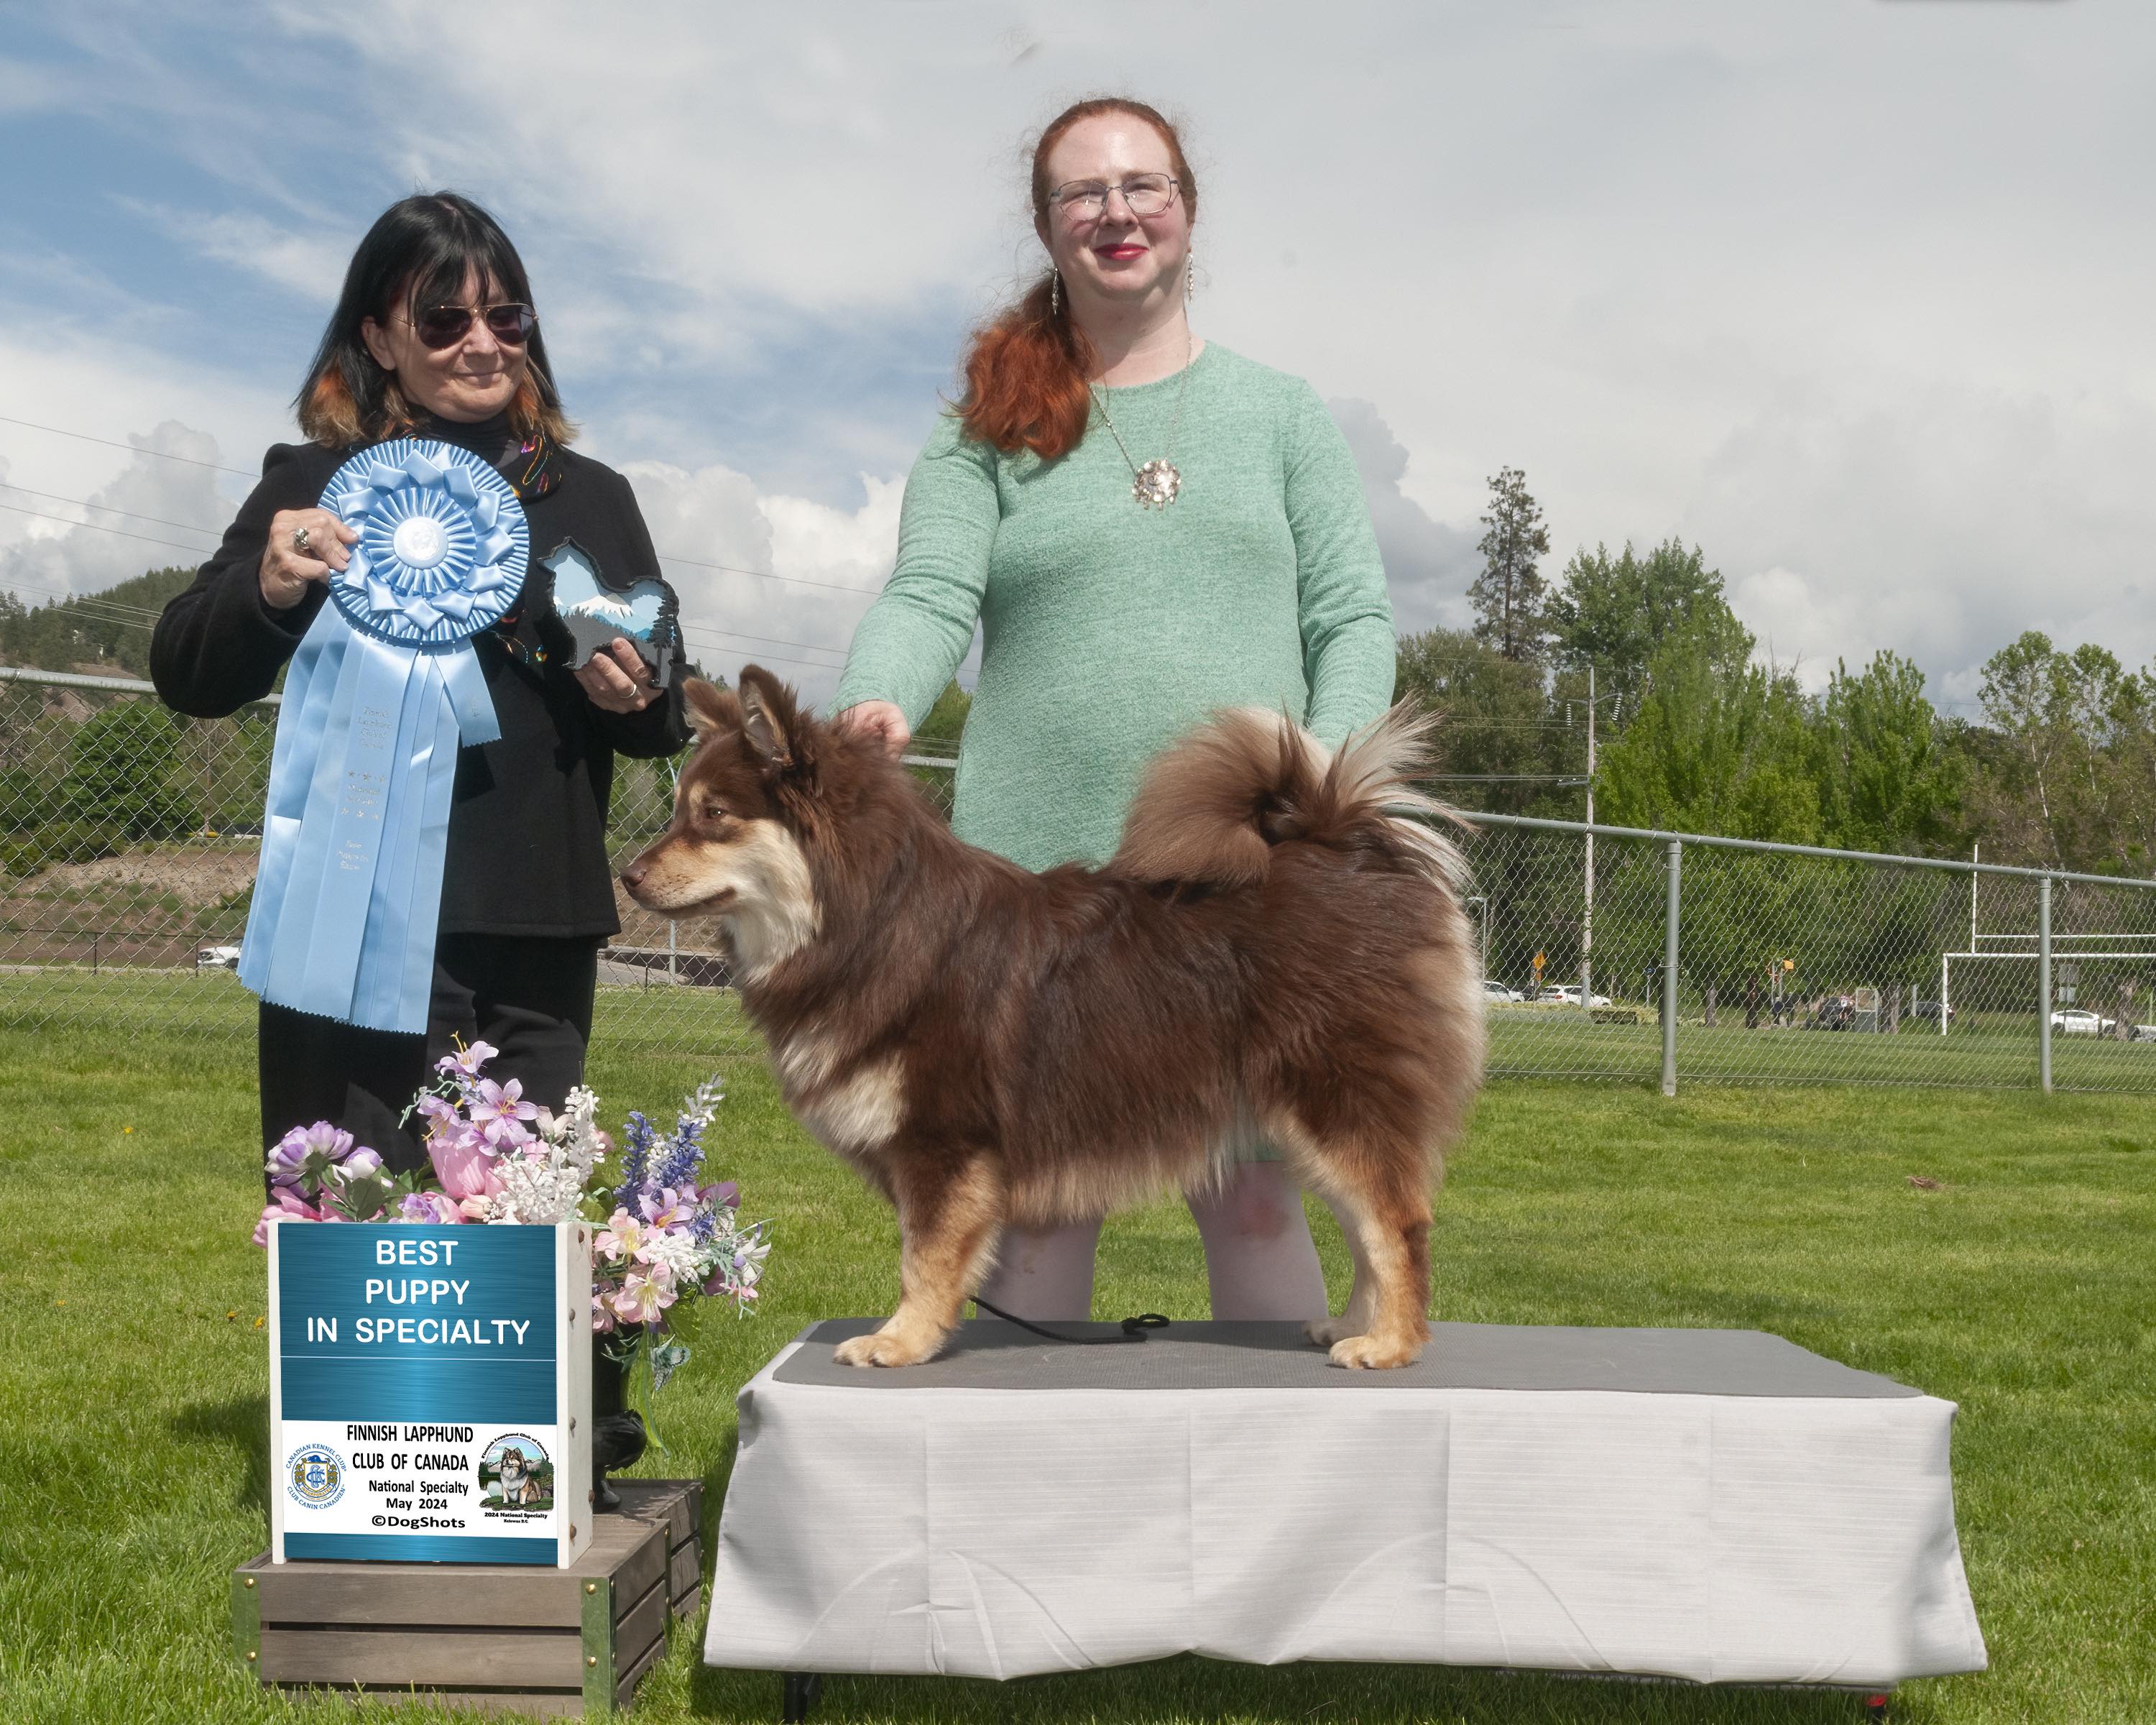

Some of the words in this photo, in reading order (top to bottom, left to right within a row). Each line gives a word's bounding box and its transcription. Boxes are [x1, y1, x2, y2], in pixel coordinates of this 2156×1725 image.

[376, 1240, 459, 1266] BEST
[366, 1279, 470, 1305] PUPPY
[308, 1317, 337, 1343] IN
[356, 1317, 530, 1345] SPECIALTY
[347, 1425, 397, 1442] FINNISH
[404, 1425, 474, 1443] LAPPHUND
[285, 1444, 310, 1469] CANADIAN
[312, 1443, 336, 1456] KENNEL
[352, 1453, 384, 1470] CLUB
[391, 1453, 408, 1470] OF
[414, 1453, 469, 1471] CANADA
[287, 1486, 299, 1501] CLUB
[298, 1499, 318, 1510] CANIN
[319, 1488, 346, 1509] CANADIEN
[369, 1479, 415, 1493] National
[420, 1481, 469, 1496] Specialty
[386, 1497, 413, 1512] May
[418, 1498, 448, 1509] 2024
